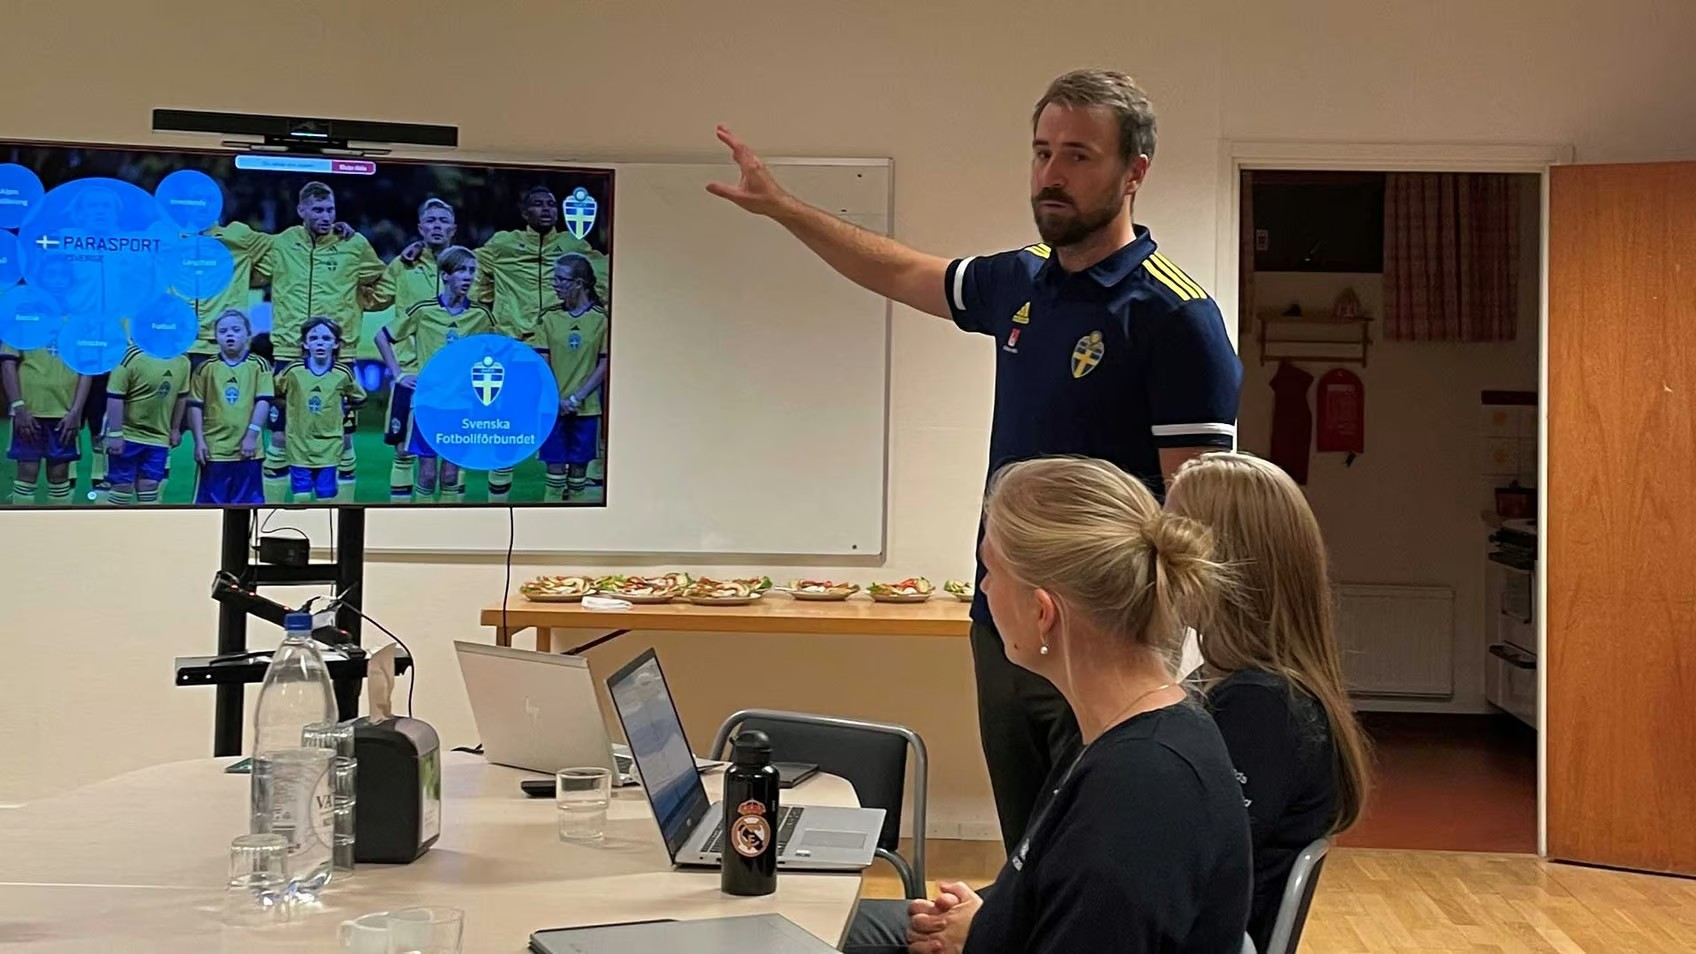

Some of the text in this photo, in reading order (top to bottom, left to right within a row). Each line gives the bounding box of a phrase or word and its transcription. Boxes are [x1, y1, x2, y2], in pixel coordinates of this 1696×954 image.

[63, 236, 161, 253] PARASPORT
[461, 418, 510, 430] Svenska
[436, 433, 535, 445] Fotbollförbundet
